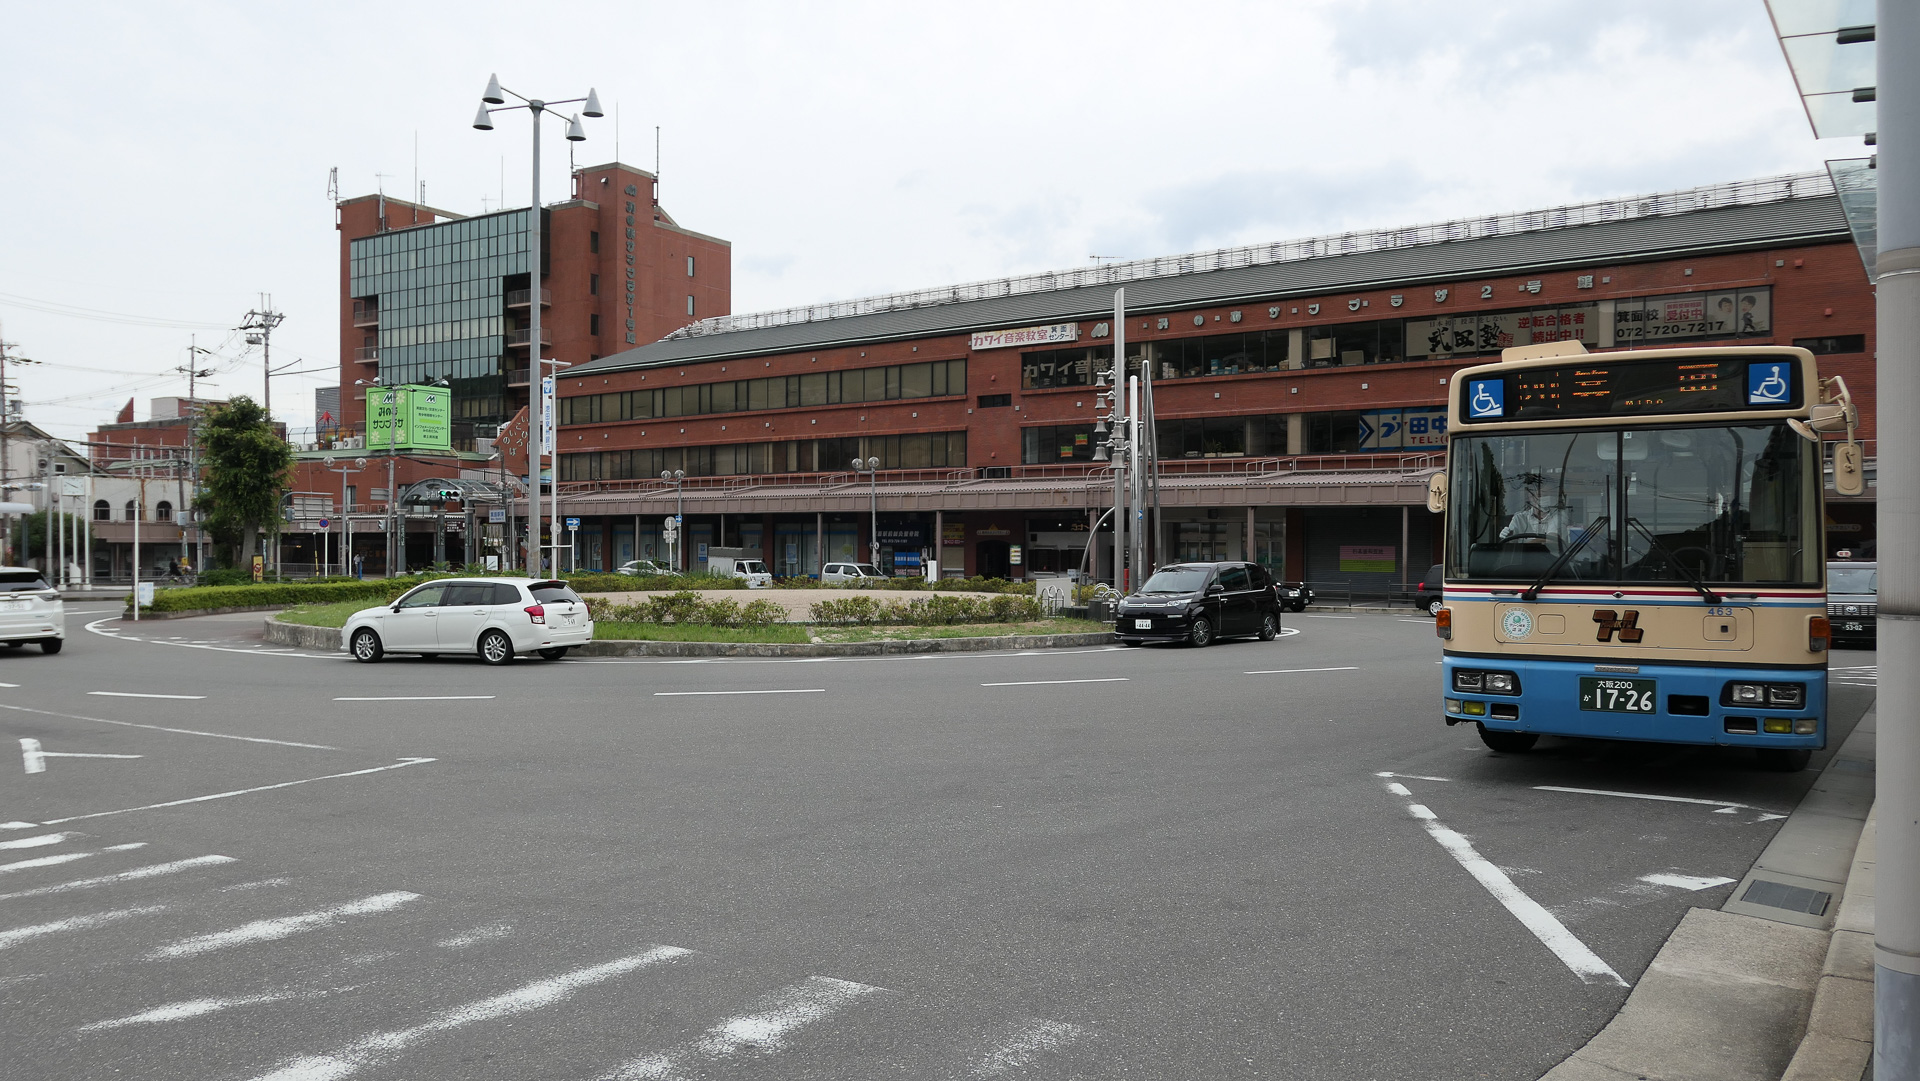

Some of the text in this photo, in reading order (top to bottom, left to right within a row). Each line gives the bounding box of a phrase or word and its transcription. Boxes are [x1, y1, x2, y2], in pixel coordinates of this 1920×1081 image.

[1518, 312, 1585, 328] 逆転合格者
[1617, 309, 1659, 323] 箕面校
[1667, 308, 1703, 320] 受付中
[1051, 324, 1067, 333] 箕面
[1616, 321, 1724, 338] 072-720-7217
[973, 329, 1048, 347] カワイ音楽教室
[1428, 322, 1504, 353] 武田塾
[1023, 355, 1144, 379] カワイ音楽室
[509, 431, 528, 456] ひろば
[1708, 607, 1732, 616] 463
[1583, 694, 1592, 702] か
[1596, 688, 1652, 711] 17-26
